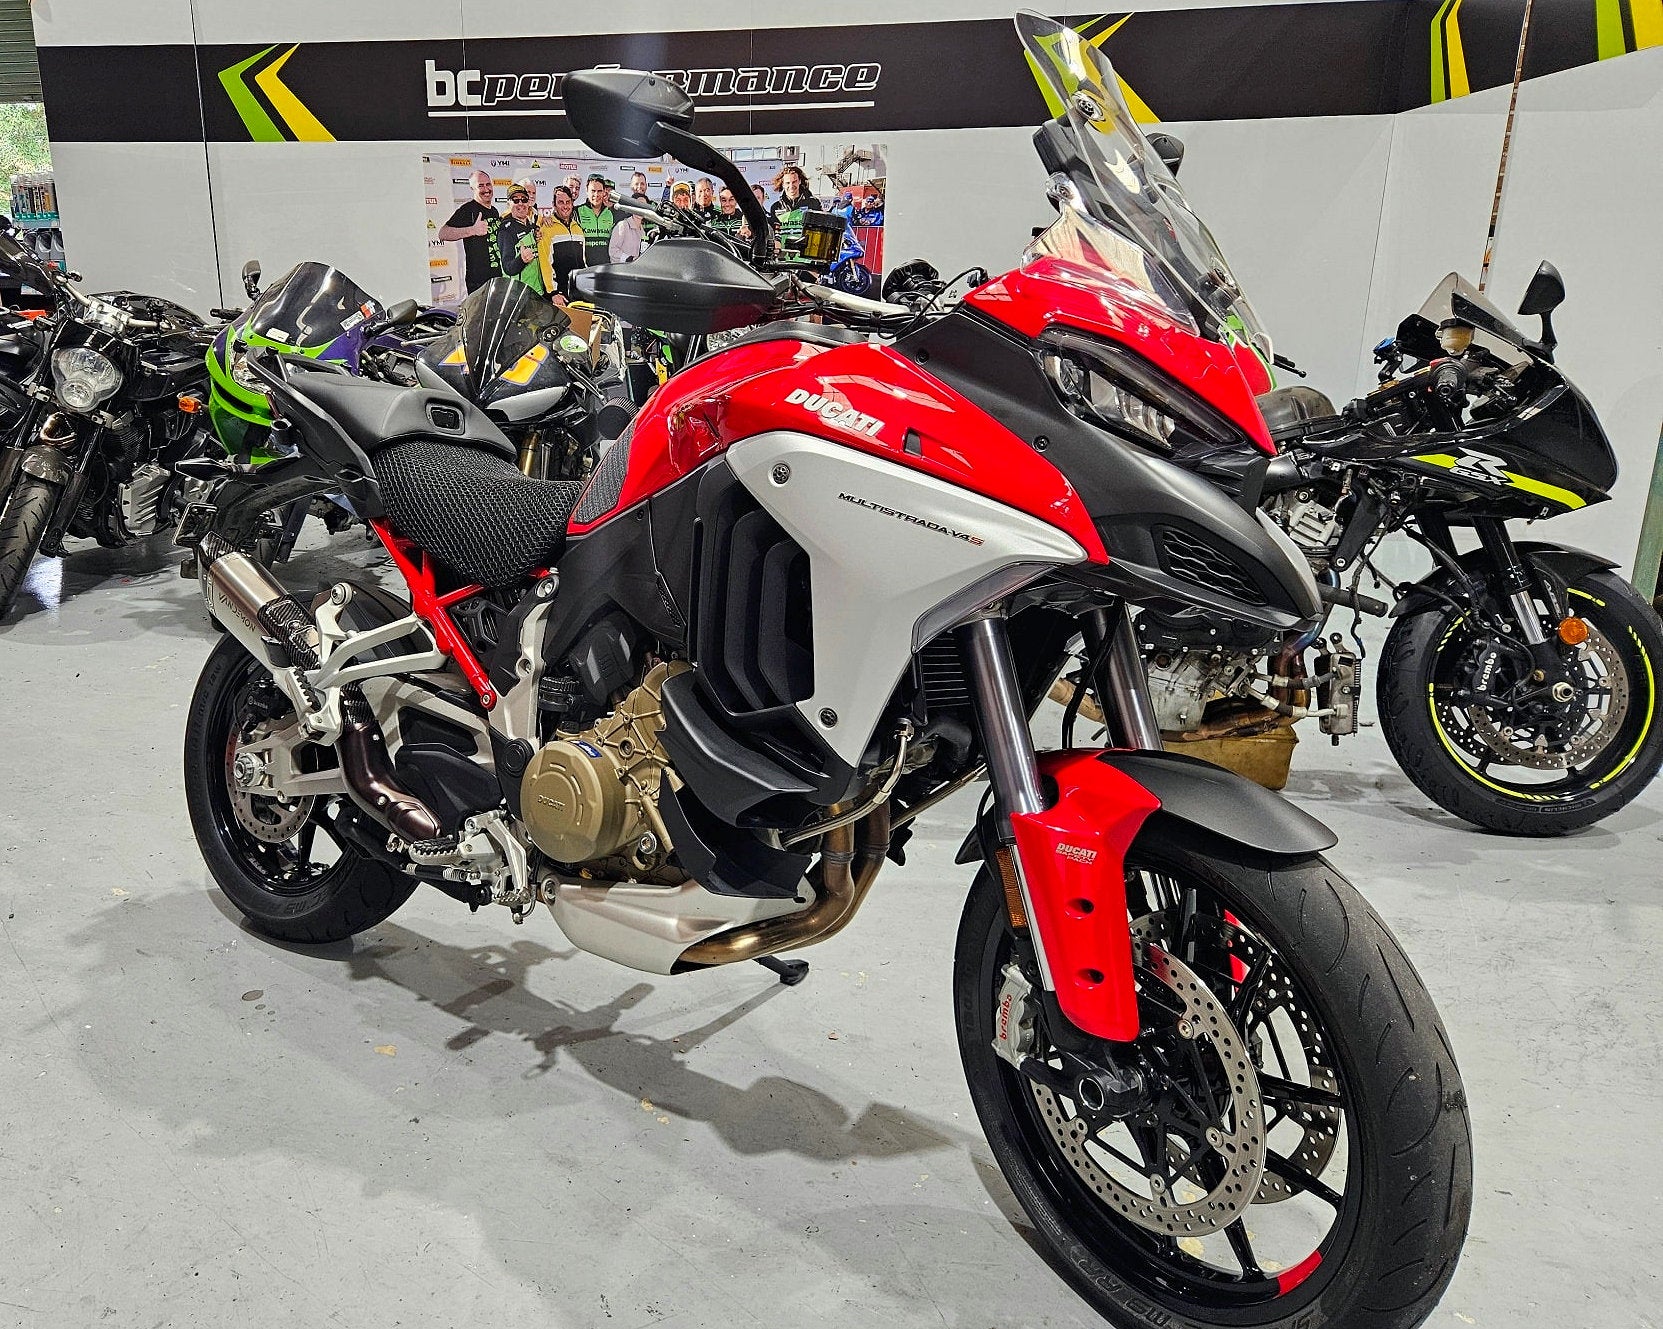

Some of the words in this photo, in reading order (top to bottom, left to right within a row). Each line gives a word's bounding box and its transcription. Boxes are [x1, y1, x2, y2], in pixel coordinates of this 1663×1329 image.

[784, 388, 885, 437] DUCATI
[1449, 467, 1507, 485] GSX
[838, 492, 949, 535] MULTISTRADA
[218, 592, 256, 633] VANDEMON
[1477, 652, 1497, 691] brembo
[1056, 842, 1097, 859] DUCATI
[999, 994, 1012, 1041] brembo
